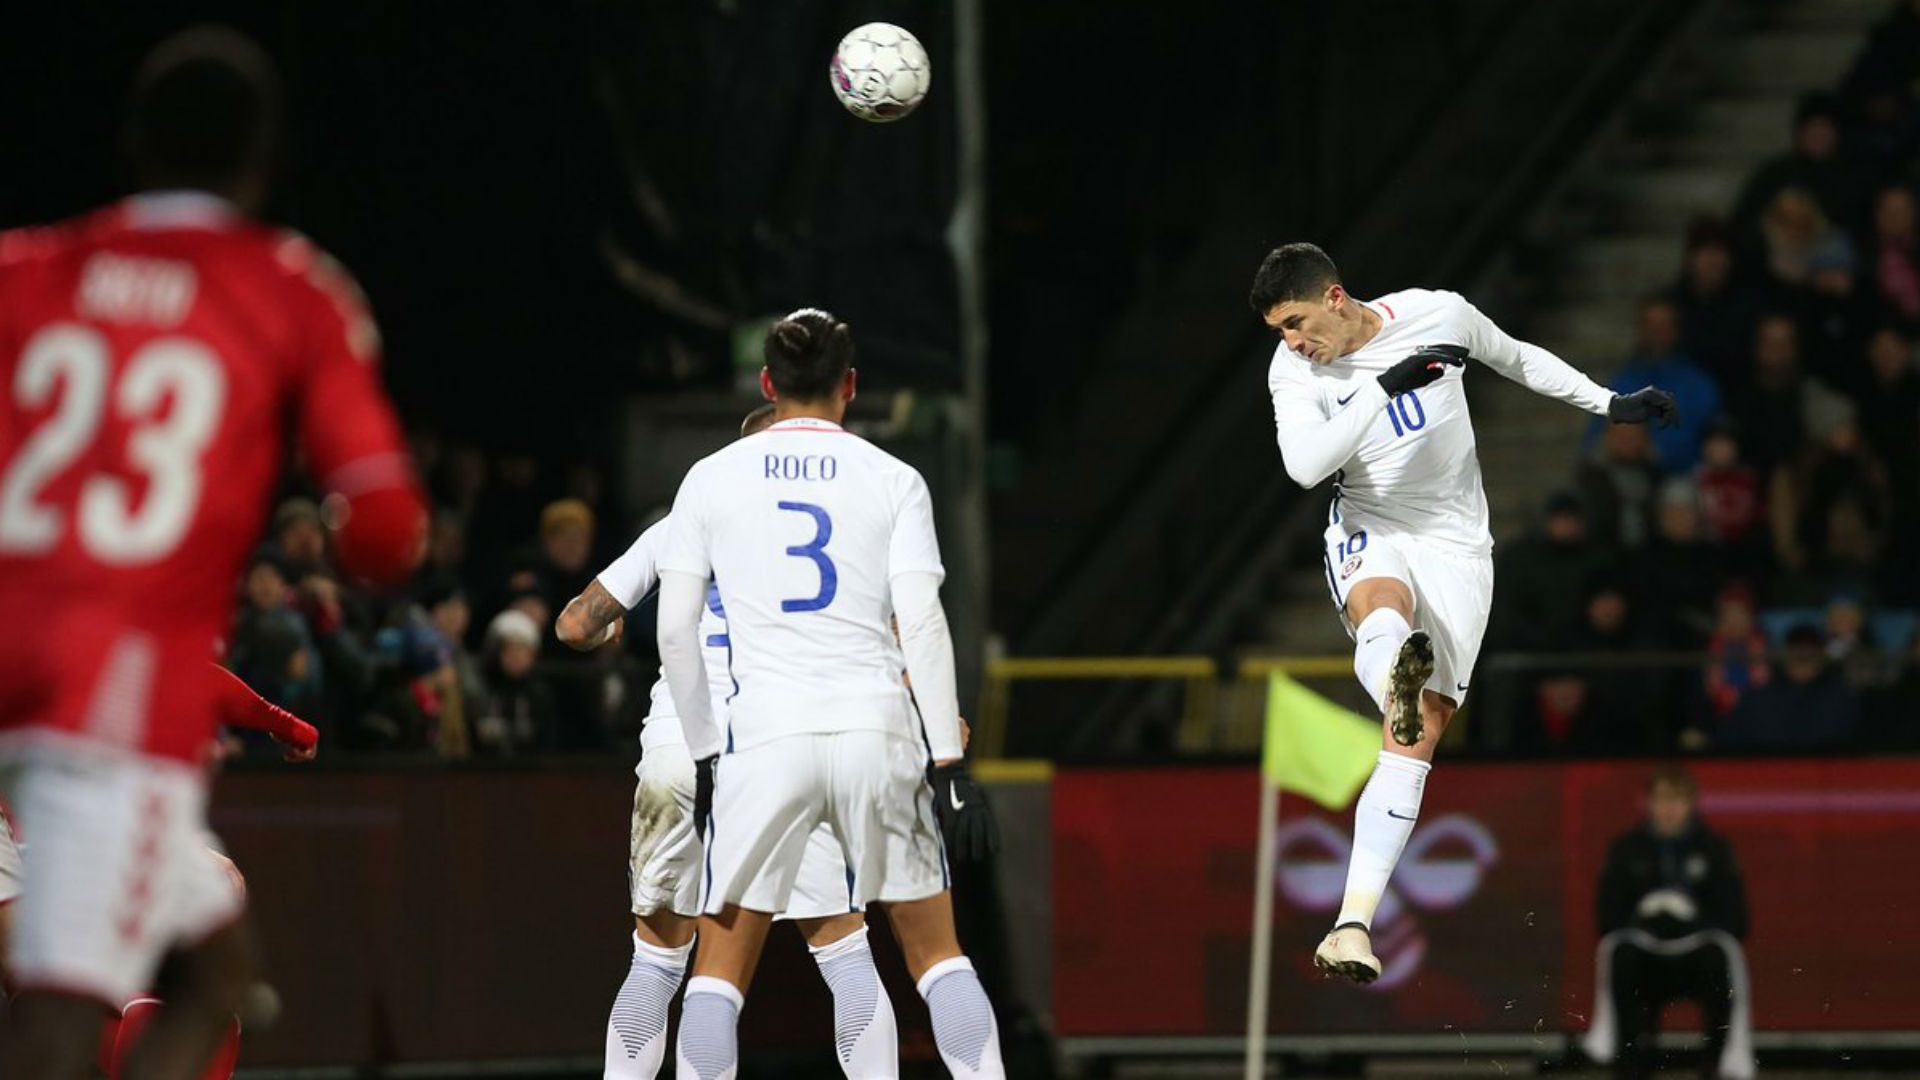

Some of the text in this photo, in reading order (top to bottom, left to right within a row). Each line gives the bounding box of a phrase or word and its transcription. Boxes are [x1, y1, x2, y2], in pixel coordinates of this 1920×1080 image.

[1386, 390, 1426, 438] 10
[0, 321, 225, 562] 23
[764, 453, 837, 481] ROCO
[777, 500, 838, 613] 3
[1336, 530, 1368, 563] 10
